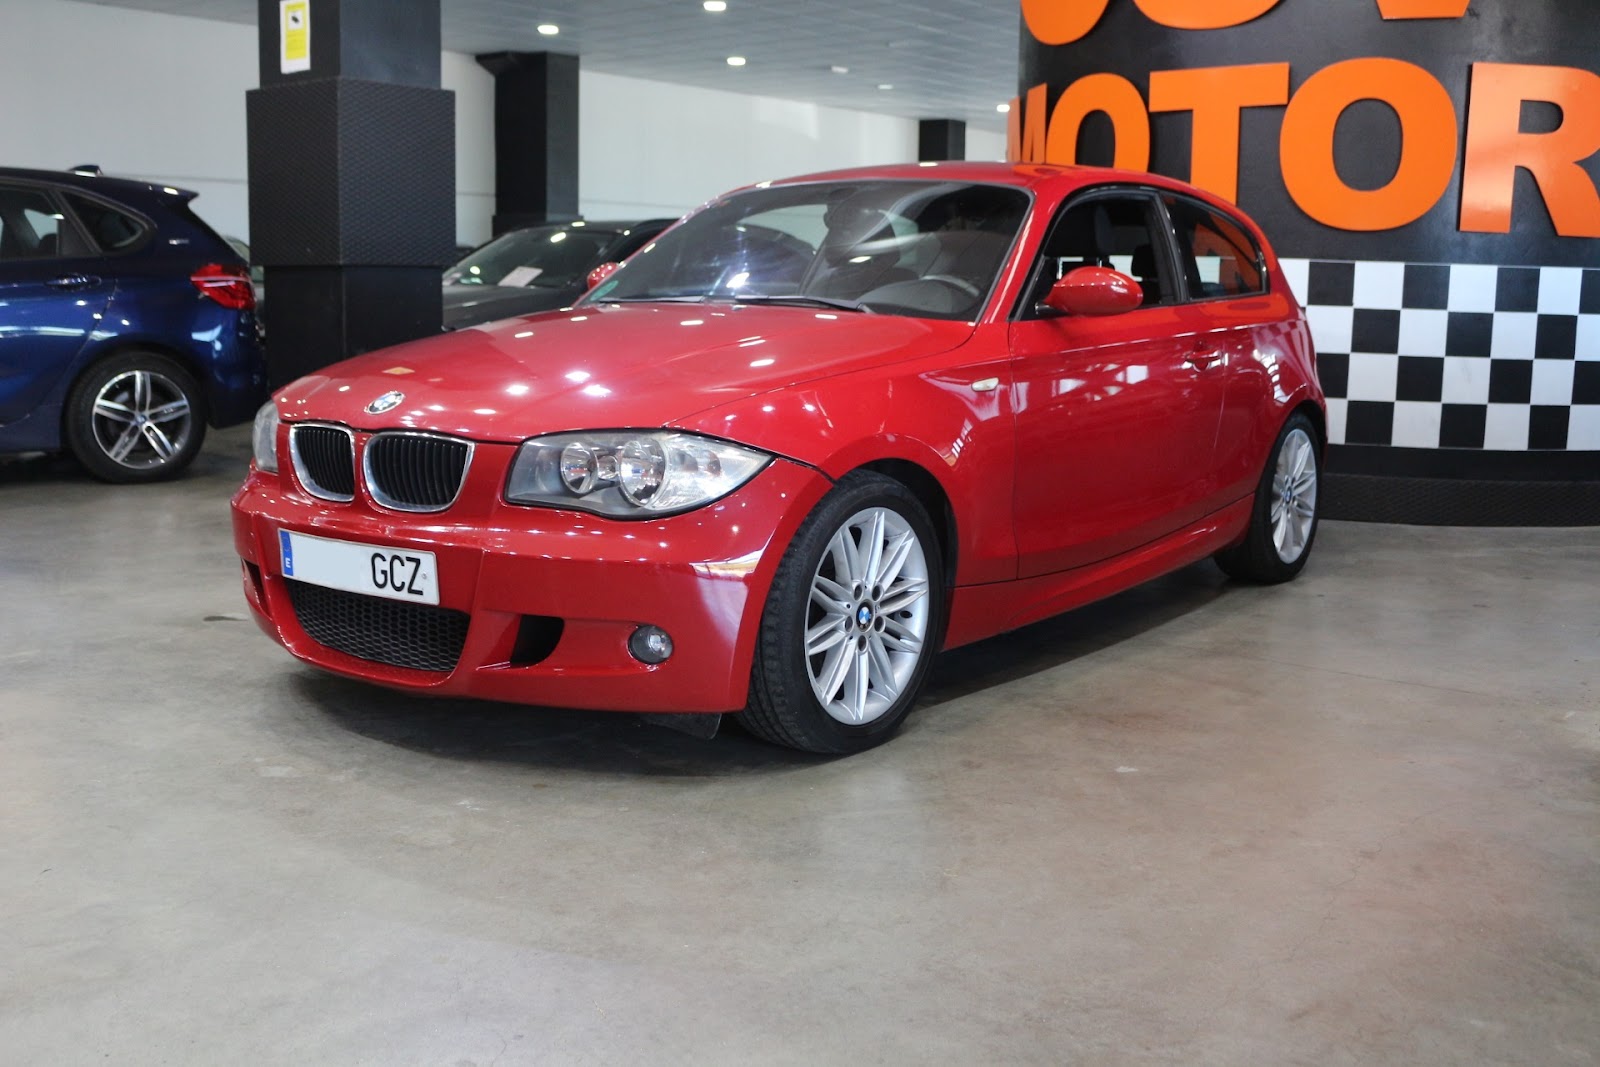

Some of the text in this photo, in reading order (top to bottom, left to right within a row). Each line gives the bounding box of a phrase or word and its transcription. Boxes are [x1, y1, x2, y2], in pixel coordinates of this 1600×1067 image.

[1007, 57, 1600, 238] MOTOR
[285, 557, 292, 569] E
[371, 552, 424, 596] GCZ
